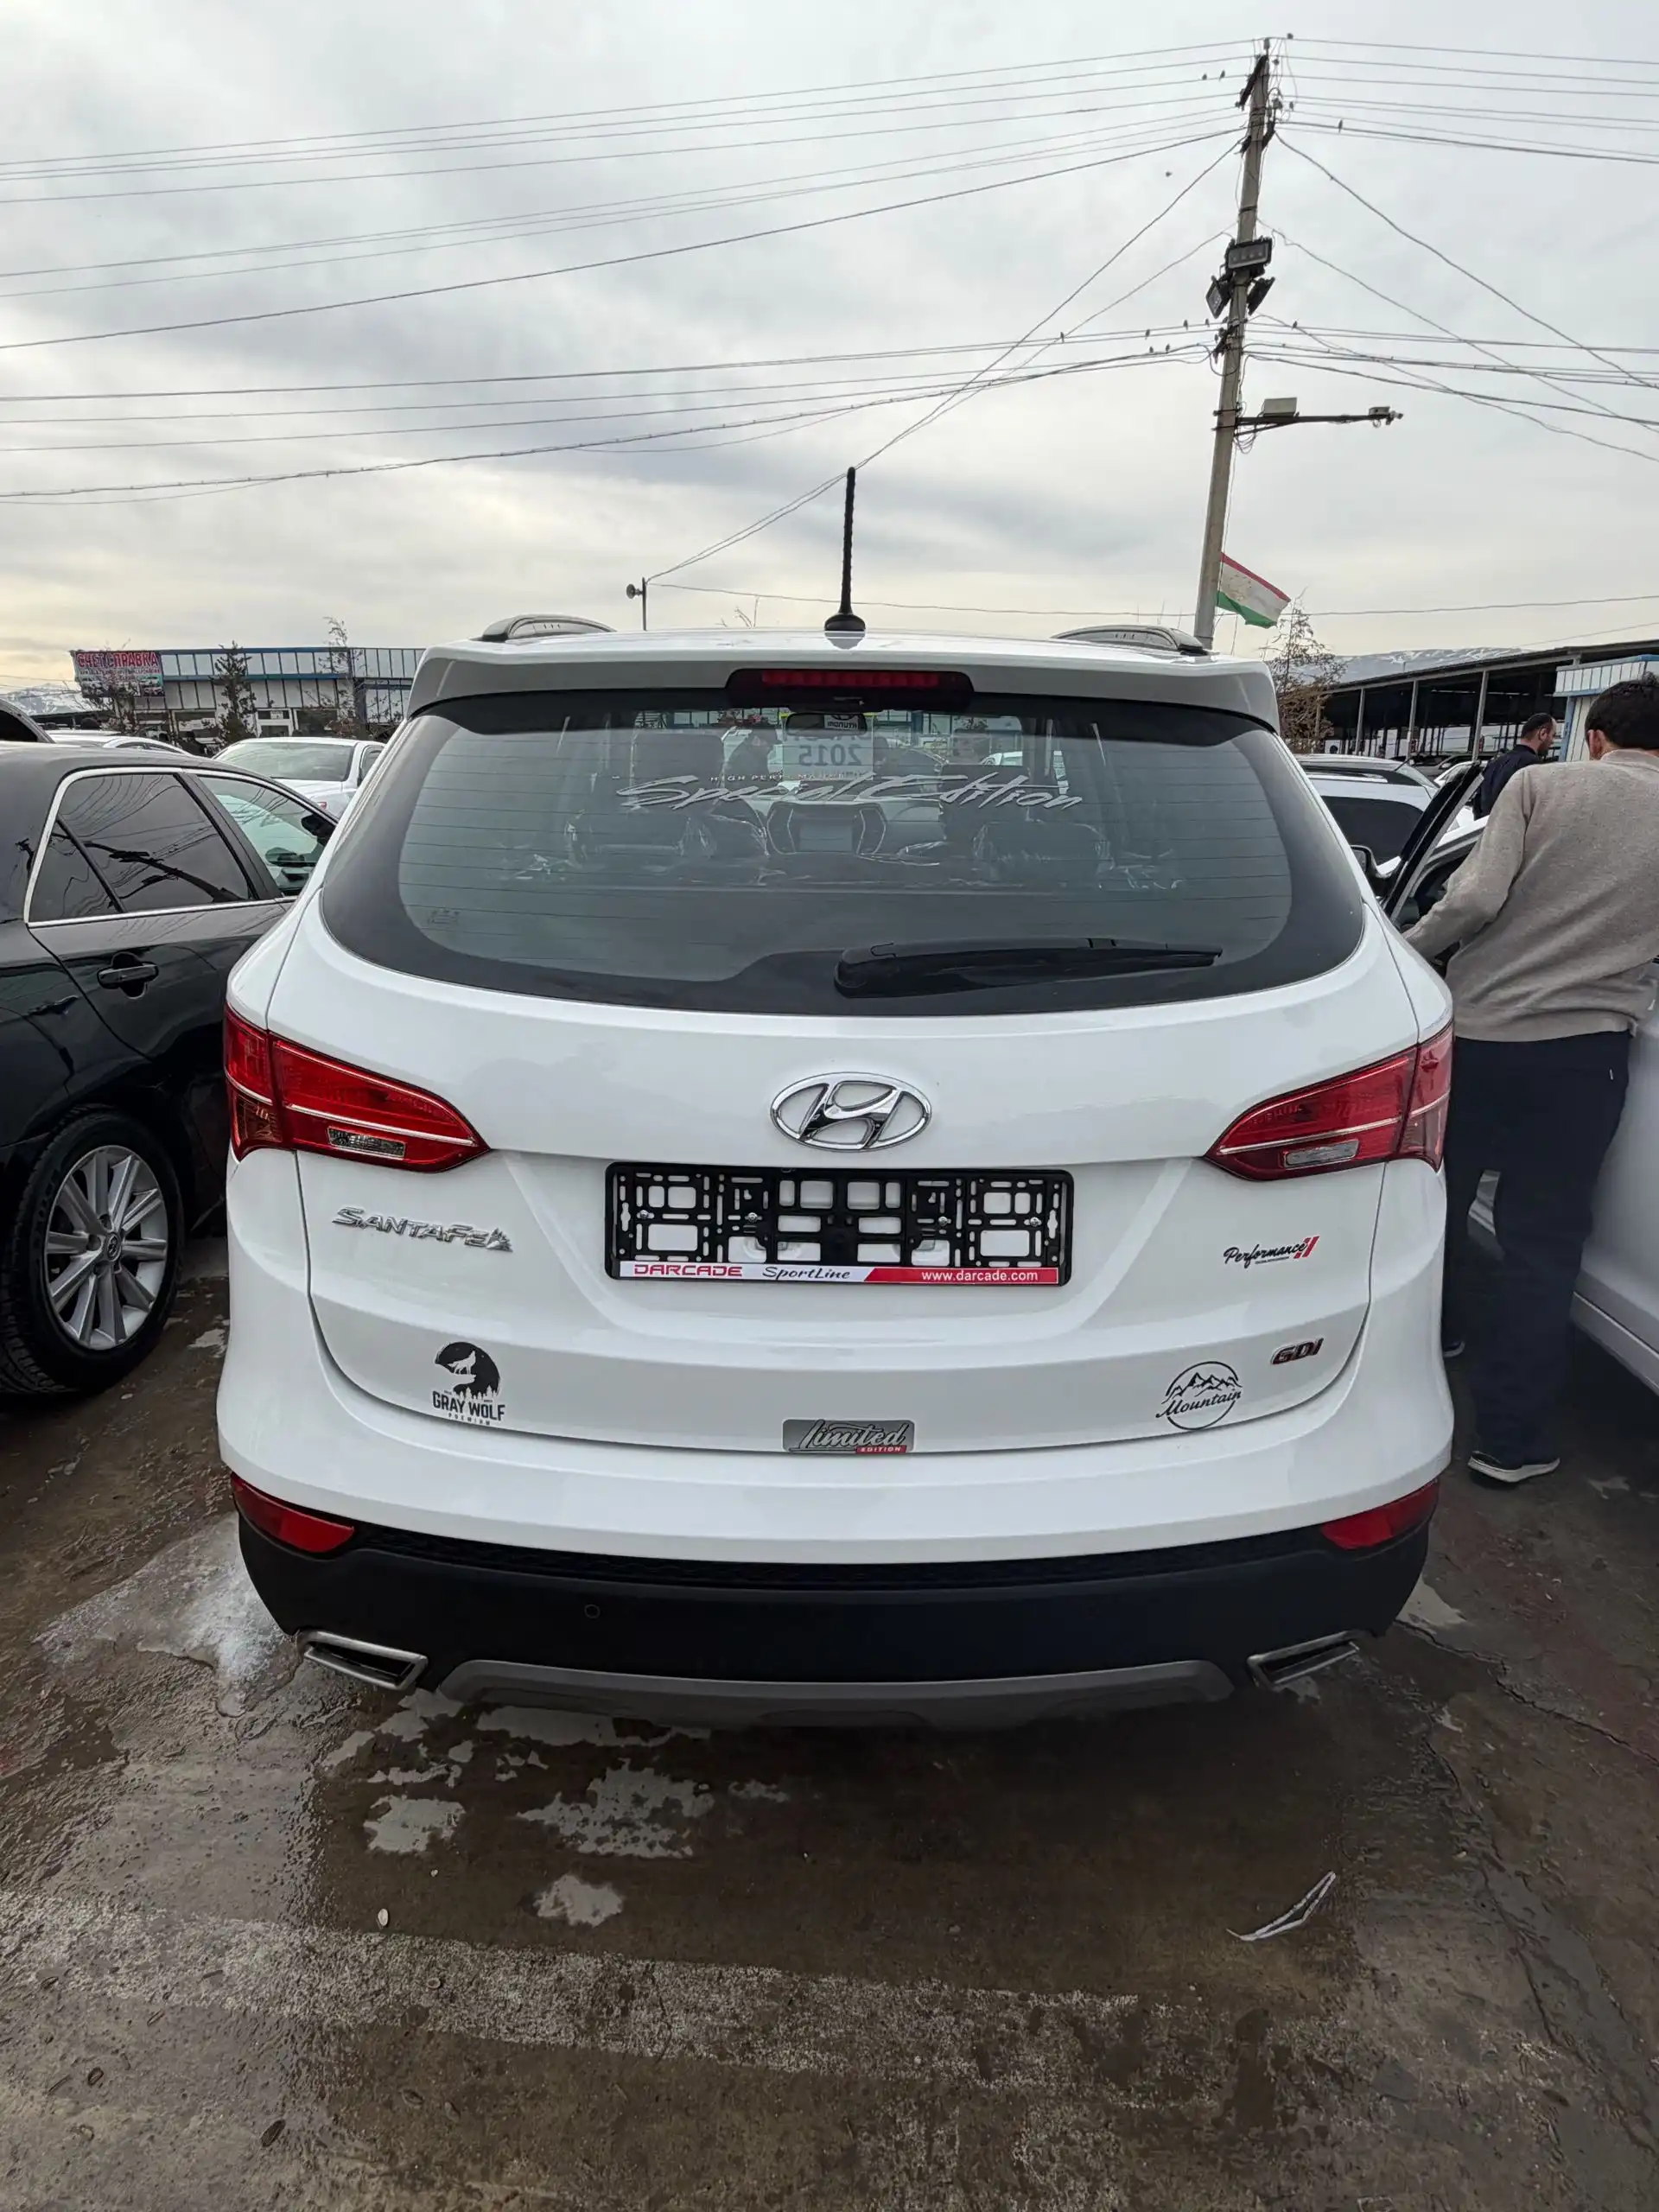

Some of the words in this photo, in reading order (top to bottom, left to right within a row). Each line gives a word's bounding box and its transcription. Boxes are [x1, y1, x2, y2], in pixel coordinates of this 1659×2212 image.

[105, 652, 159, 667] СПРАВКА
[855, 772, 1082, 810] Edition
[1224, 1243, 1306, 1268] Performance
[634, 1264, 742, 1277] DARCADE
[762, 1266, 850, 1280] SportLine
[921, 1268, 1038, 1281] www.darcade.com
[1271, 1338, 1324, 1365] GDI
[432, 1390, 465, 1414] GRAY
[468, 1401, 505, 1421] WOLF
[1155, 1388, 1243, 1418] Mountain
[790, 1419, 910, 1452] Limited
